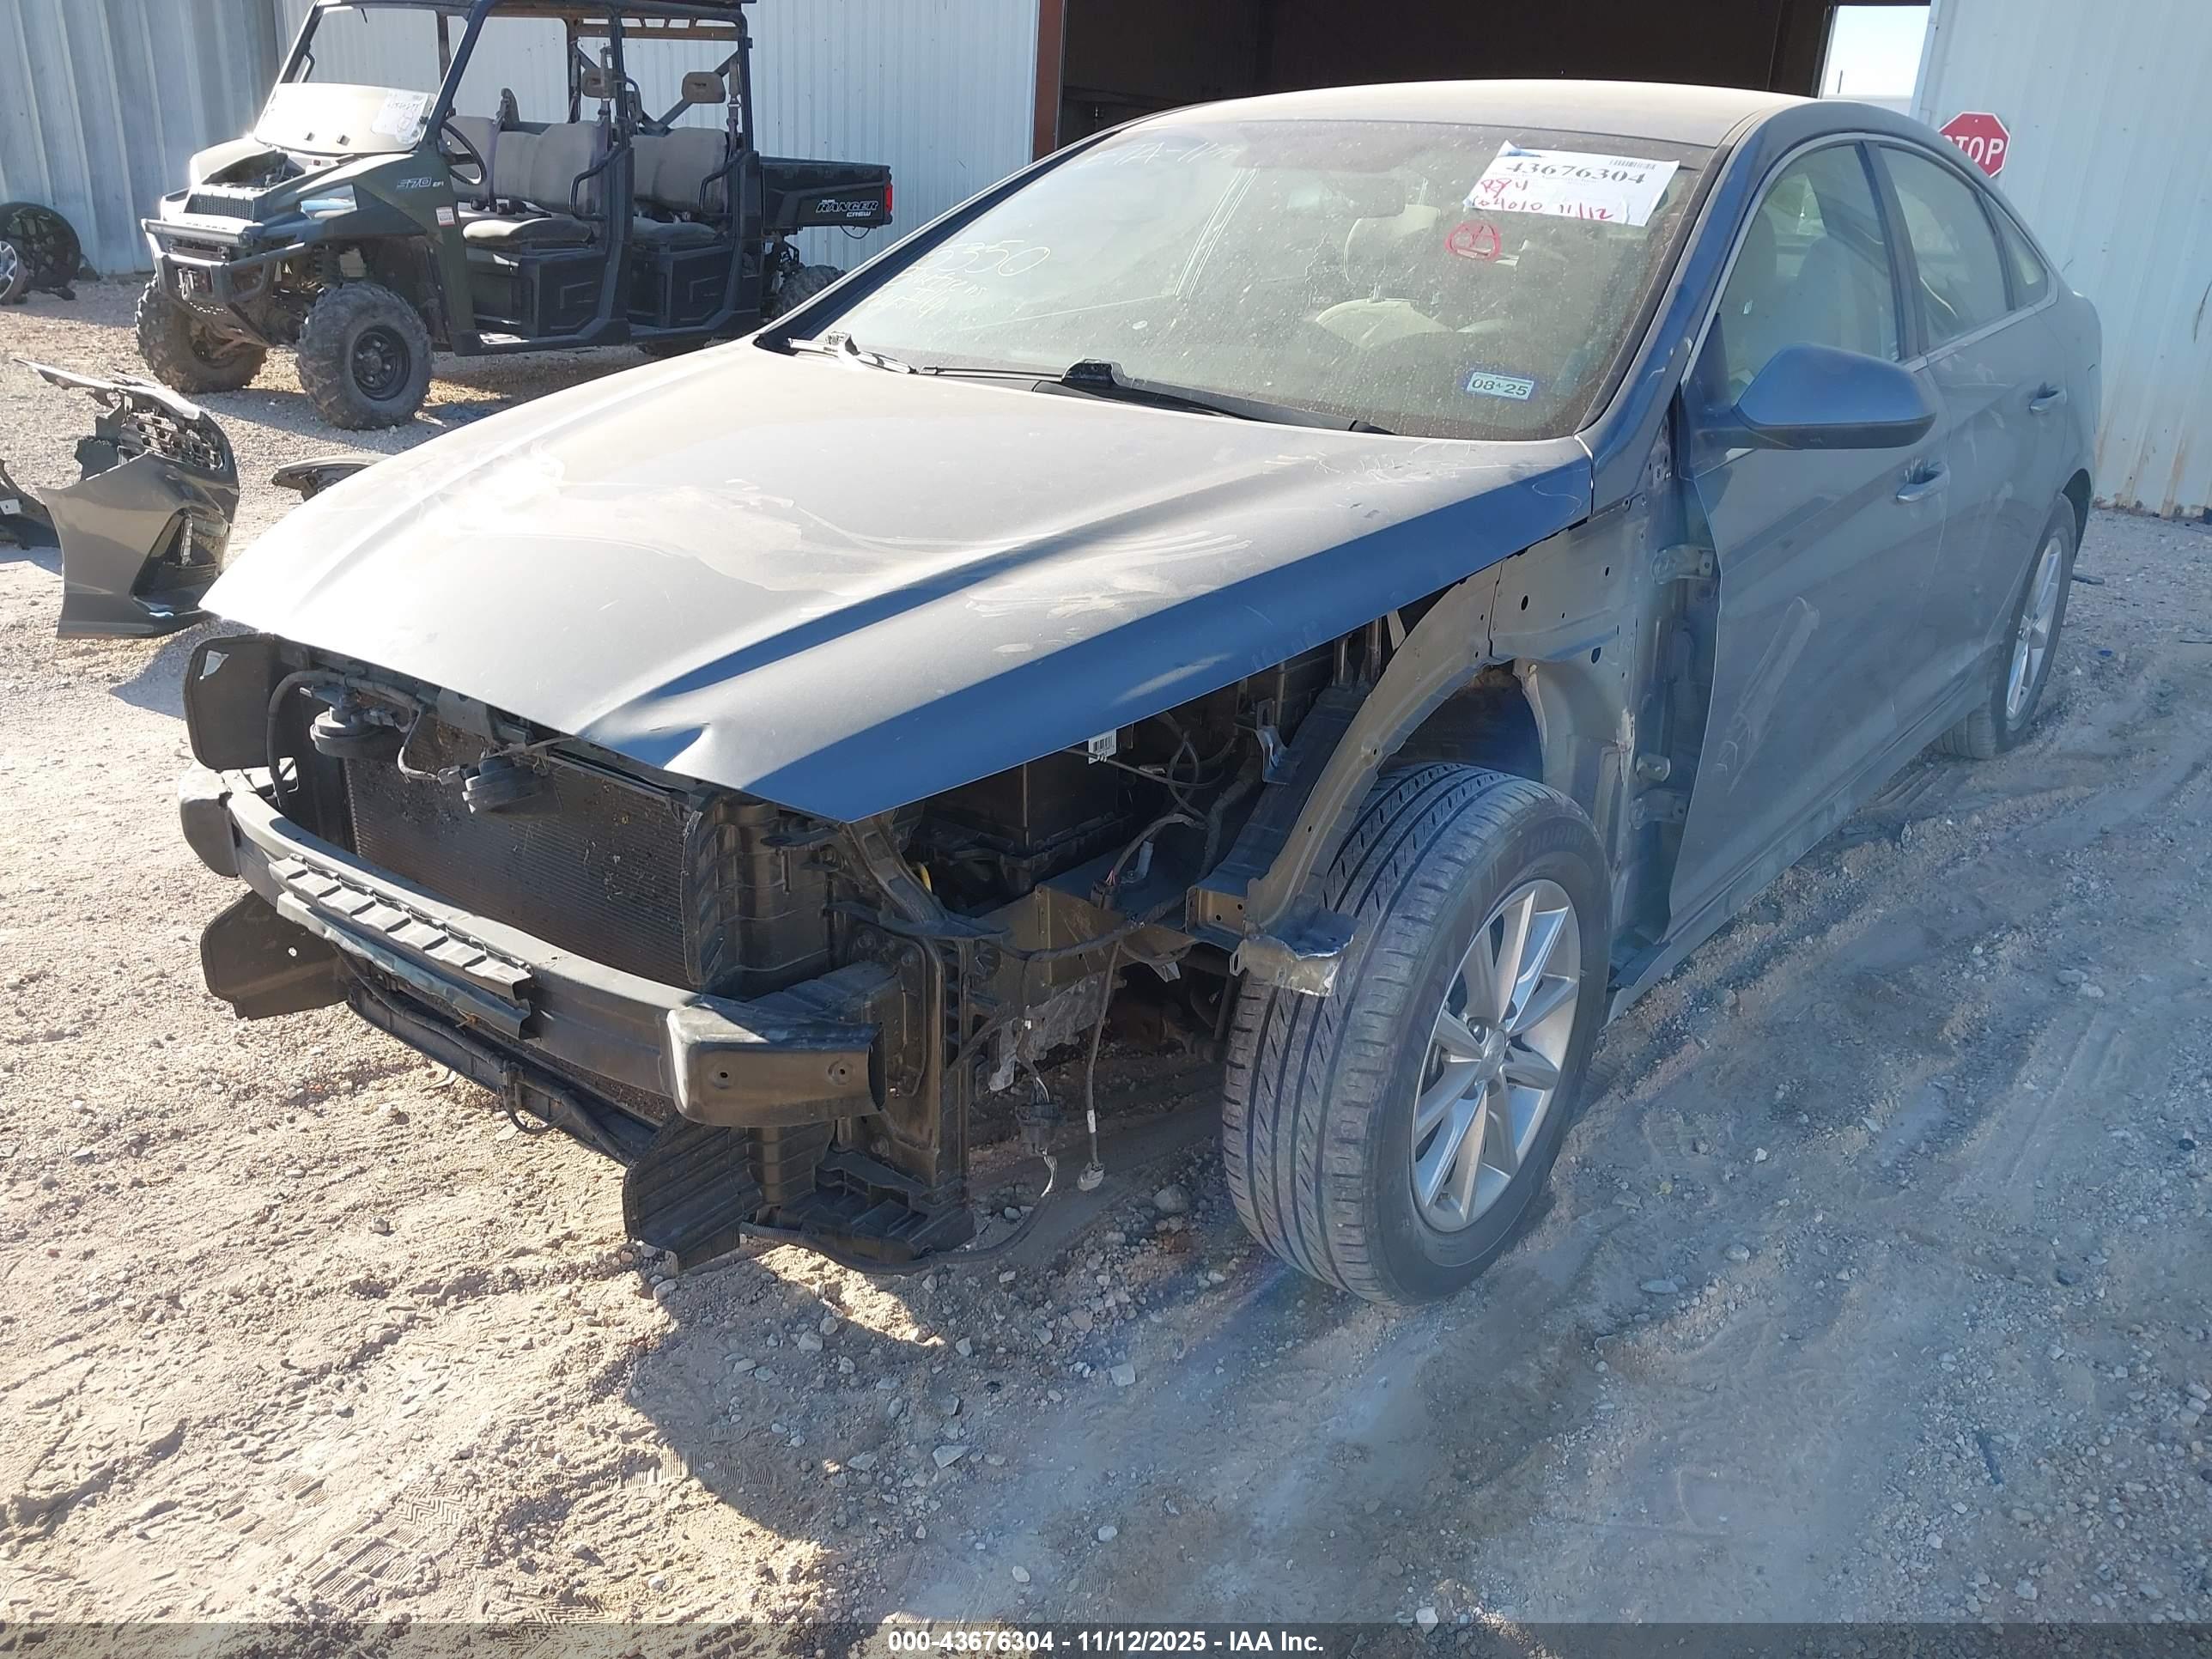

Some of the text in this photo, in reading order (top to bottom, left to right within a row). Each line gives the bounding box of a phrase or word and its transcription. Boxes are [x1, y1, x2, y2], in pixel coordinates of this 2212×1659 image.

[1944, 135, 2004, 165] TOP
[1506, 162, 1646, 184] 43676304
[397, 177, 432, 189] 570
[815, 200, 879, 213] RANGER
